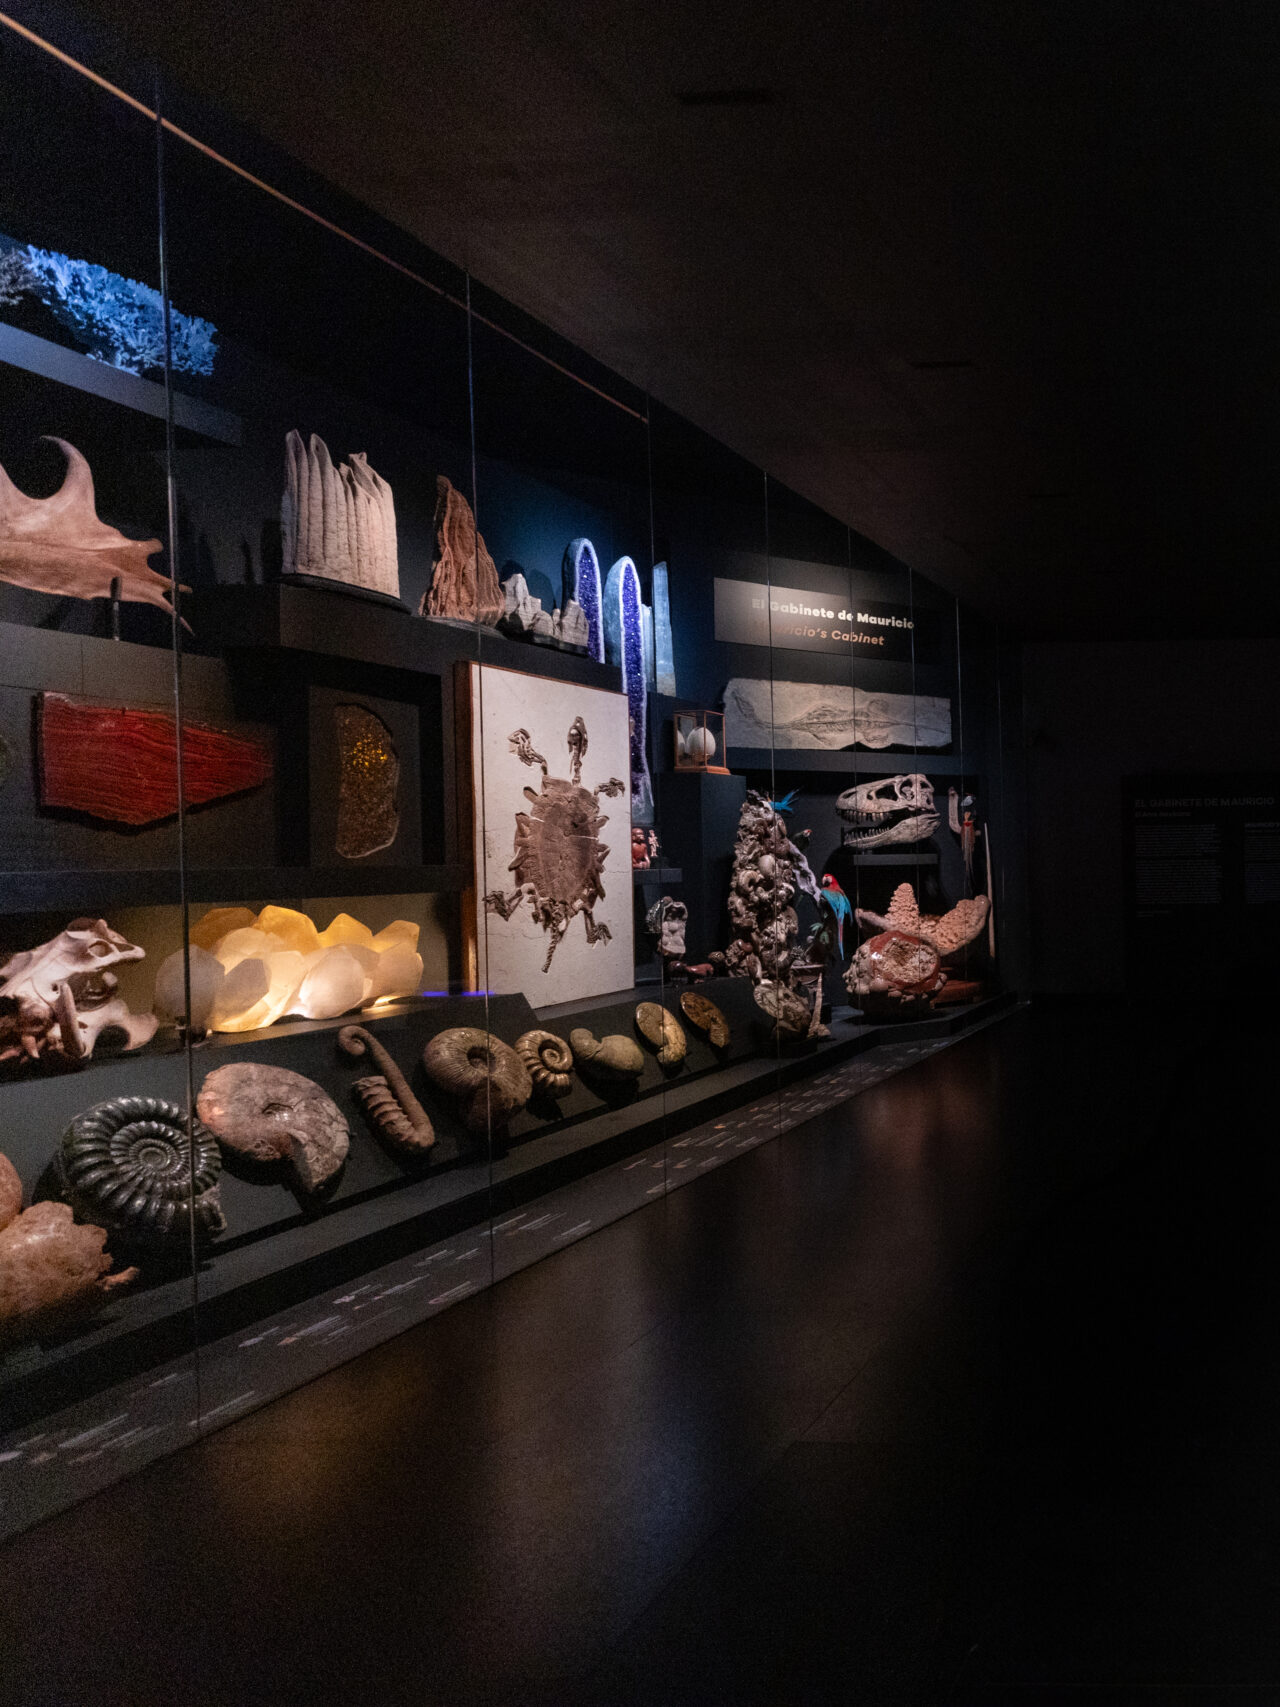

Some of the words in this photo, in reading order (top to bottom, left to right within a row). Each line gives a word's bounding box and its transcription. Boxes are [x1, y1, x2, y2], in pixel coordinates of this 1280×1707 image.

[752, 599, 765, 610] El
[770, 601, 835, 619] Gabinete
[838, 609, 854, 622] de
[857, 612, 914, 630] Mauricio
[831, 629, 885, 647] Cabinet
